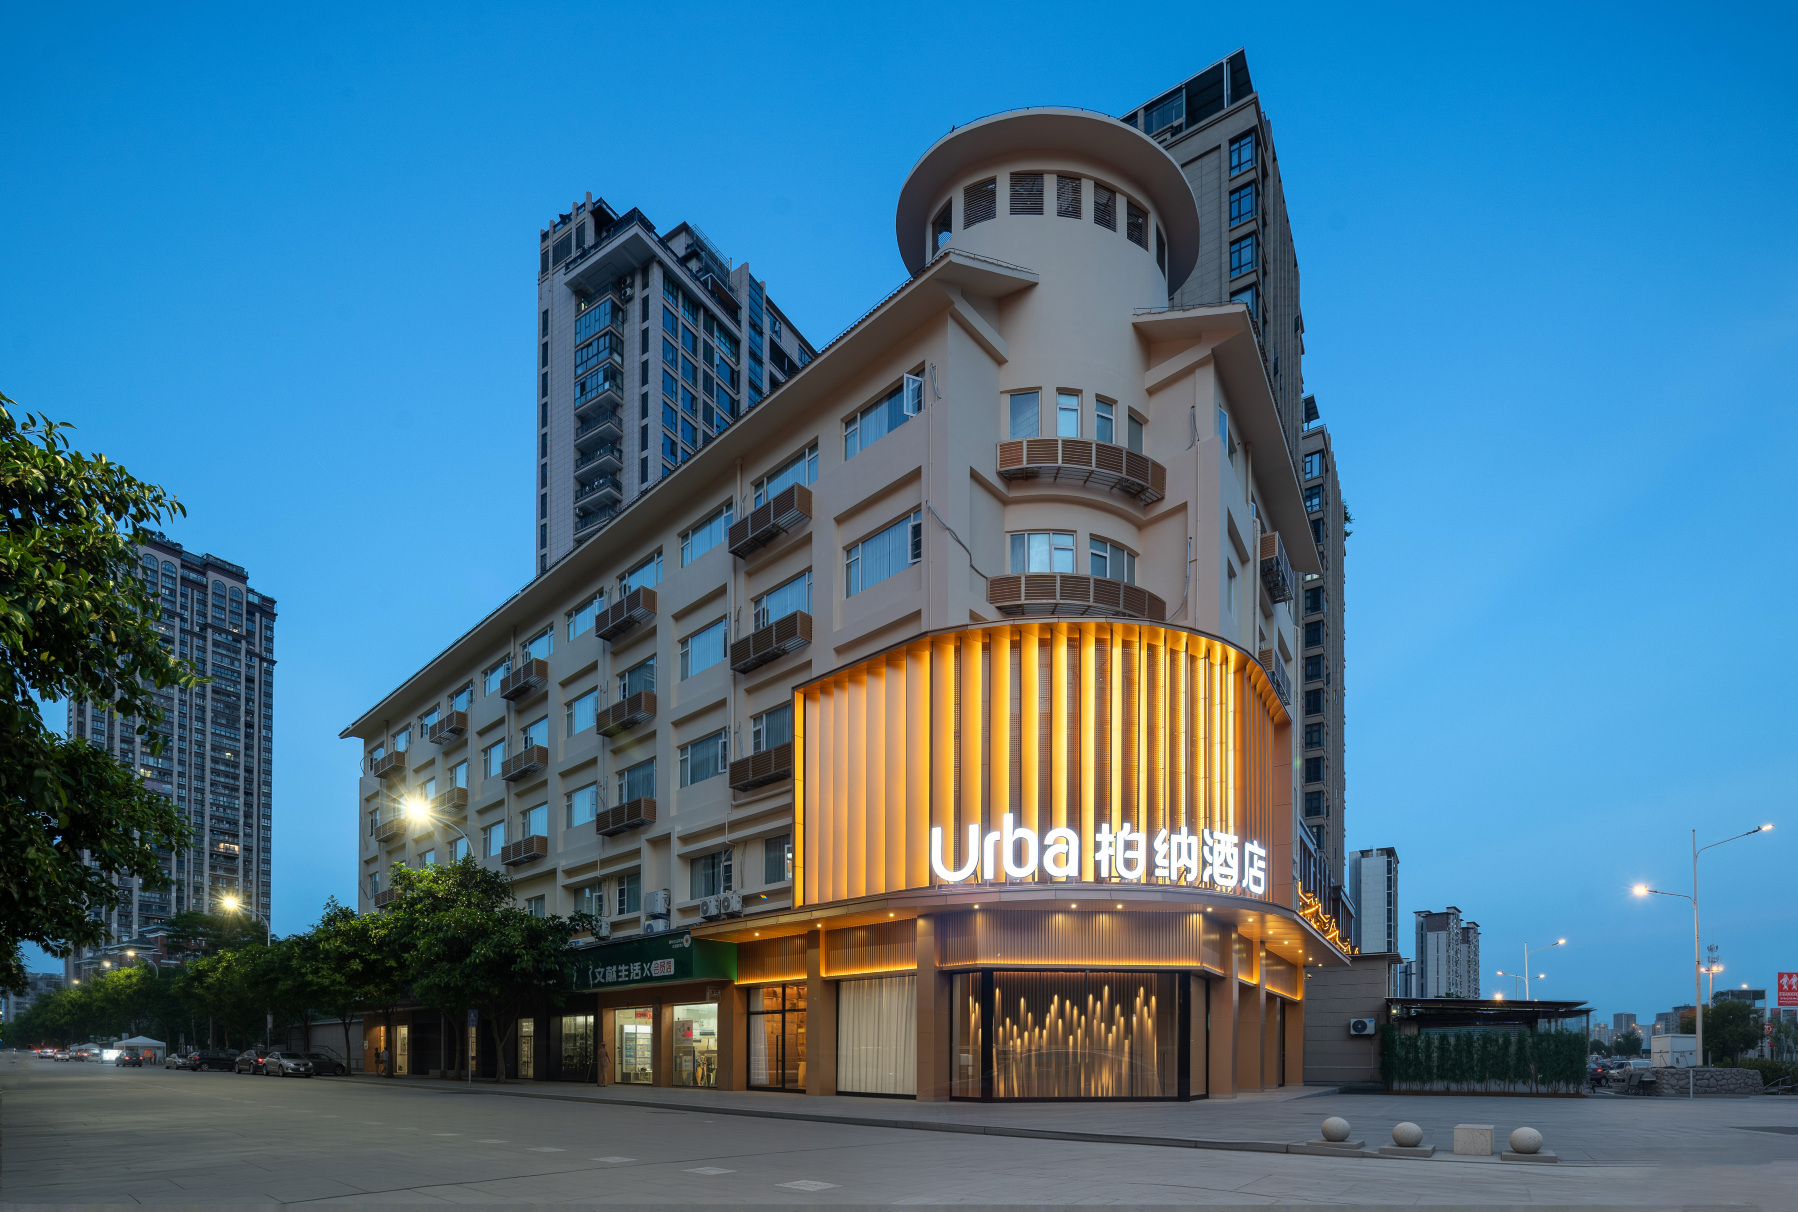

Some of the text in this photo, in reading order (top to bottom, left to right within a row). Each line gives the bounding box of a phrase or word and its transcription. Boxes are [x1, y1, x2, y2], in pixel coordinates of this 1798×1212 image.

[931, 812, 1267, 895] Urba 柏纳酒店
